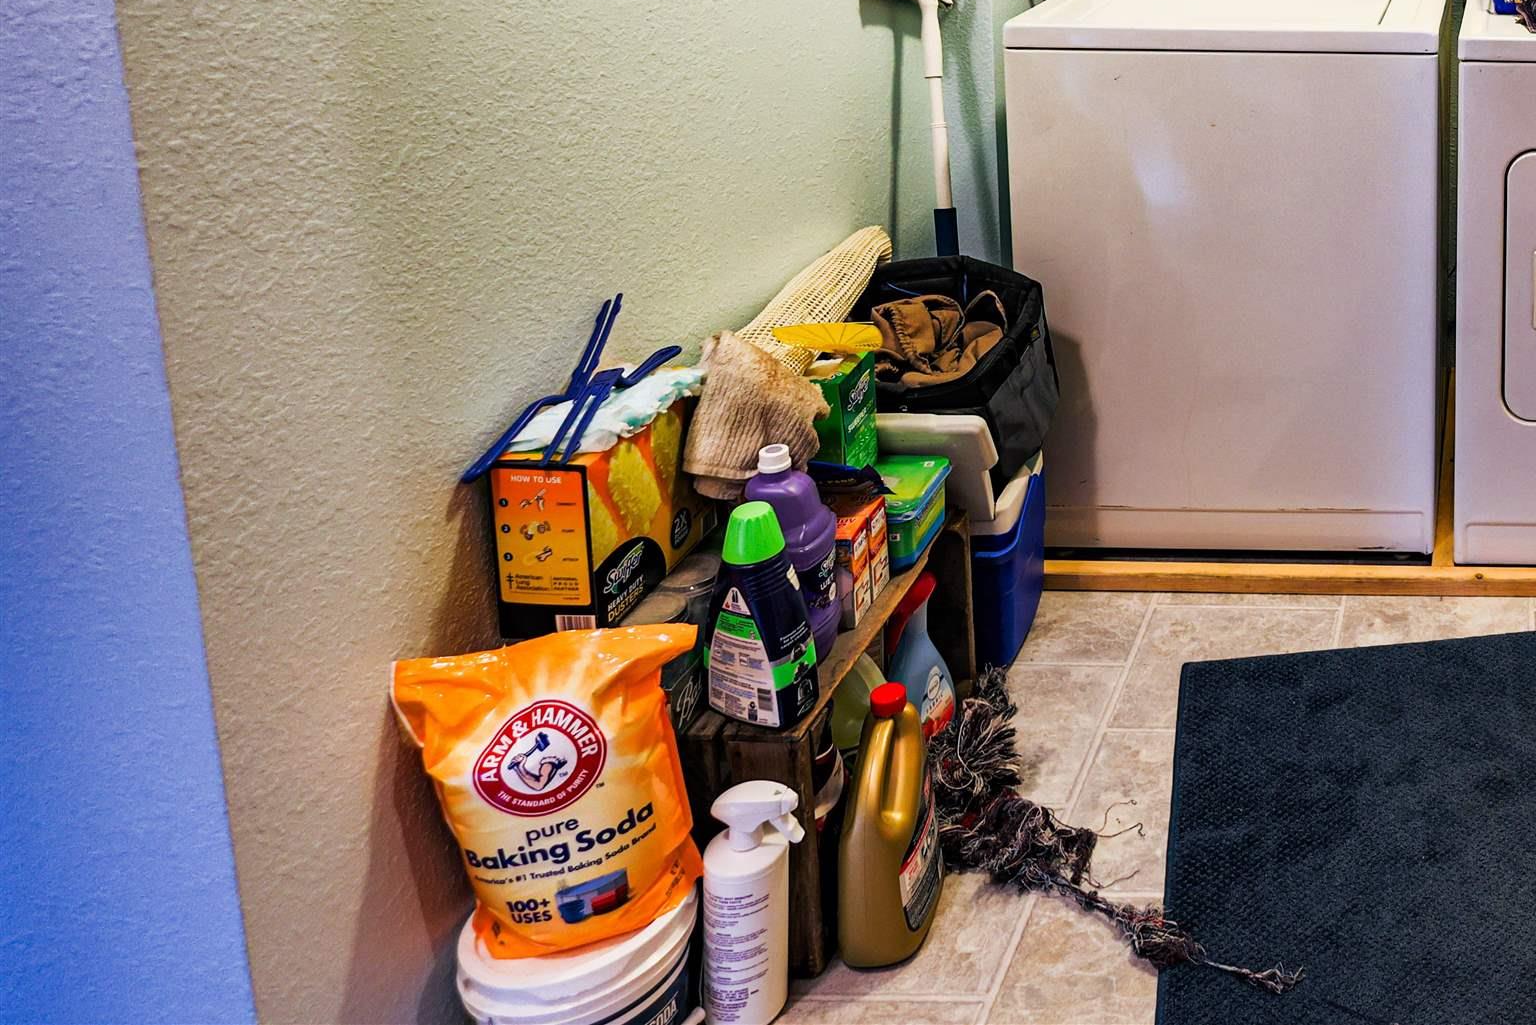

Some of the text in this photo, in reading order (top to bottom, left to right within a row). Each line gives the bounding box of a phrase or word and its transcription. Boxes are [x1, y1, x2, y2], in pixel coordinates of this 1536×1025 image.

[510, 474, 562, 484] HOW TO USE
[603, 541, 645, 594] Swiffer
[607, 587, 629, 612] HEAVY
[607, 585, 645, 622] DUSTERS
[480, 707, 599, 782] ARM & HAMMER
[497, 790, 513, 803] THE
[512, 796, 557, 808] STANDARD
[556, 791, 569, 800] OF
[566, 768, 590, 793] PURITY
[464, 802, 655, 871] Baking Soda
[525, 818, 580, 847] pure
[530, 866, 565, 880] Trusted
[567, 857, 603, 872] Baking
[604, 842, 631, 860] Soda
[631, 822, 657, 845] Brand
[505, 898, 551, 913] 100+
[511, 911, 553, 924] USES
